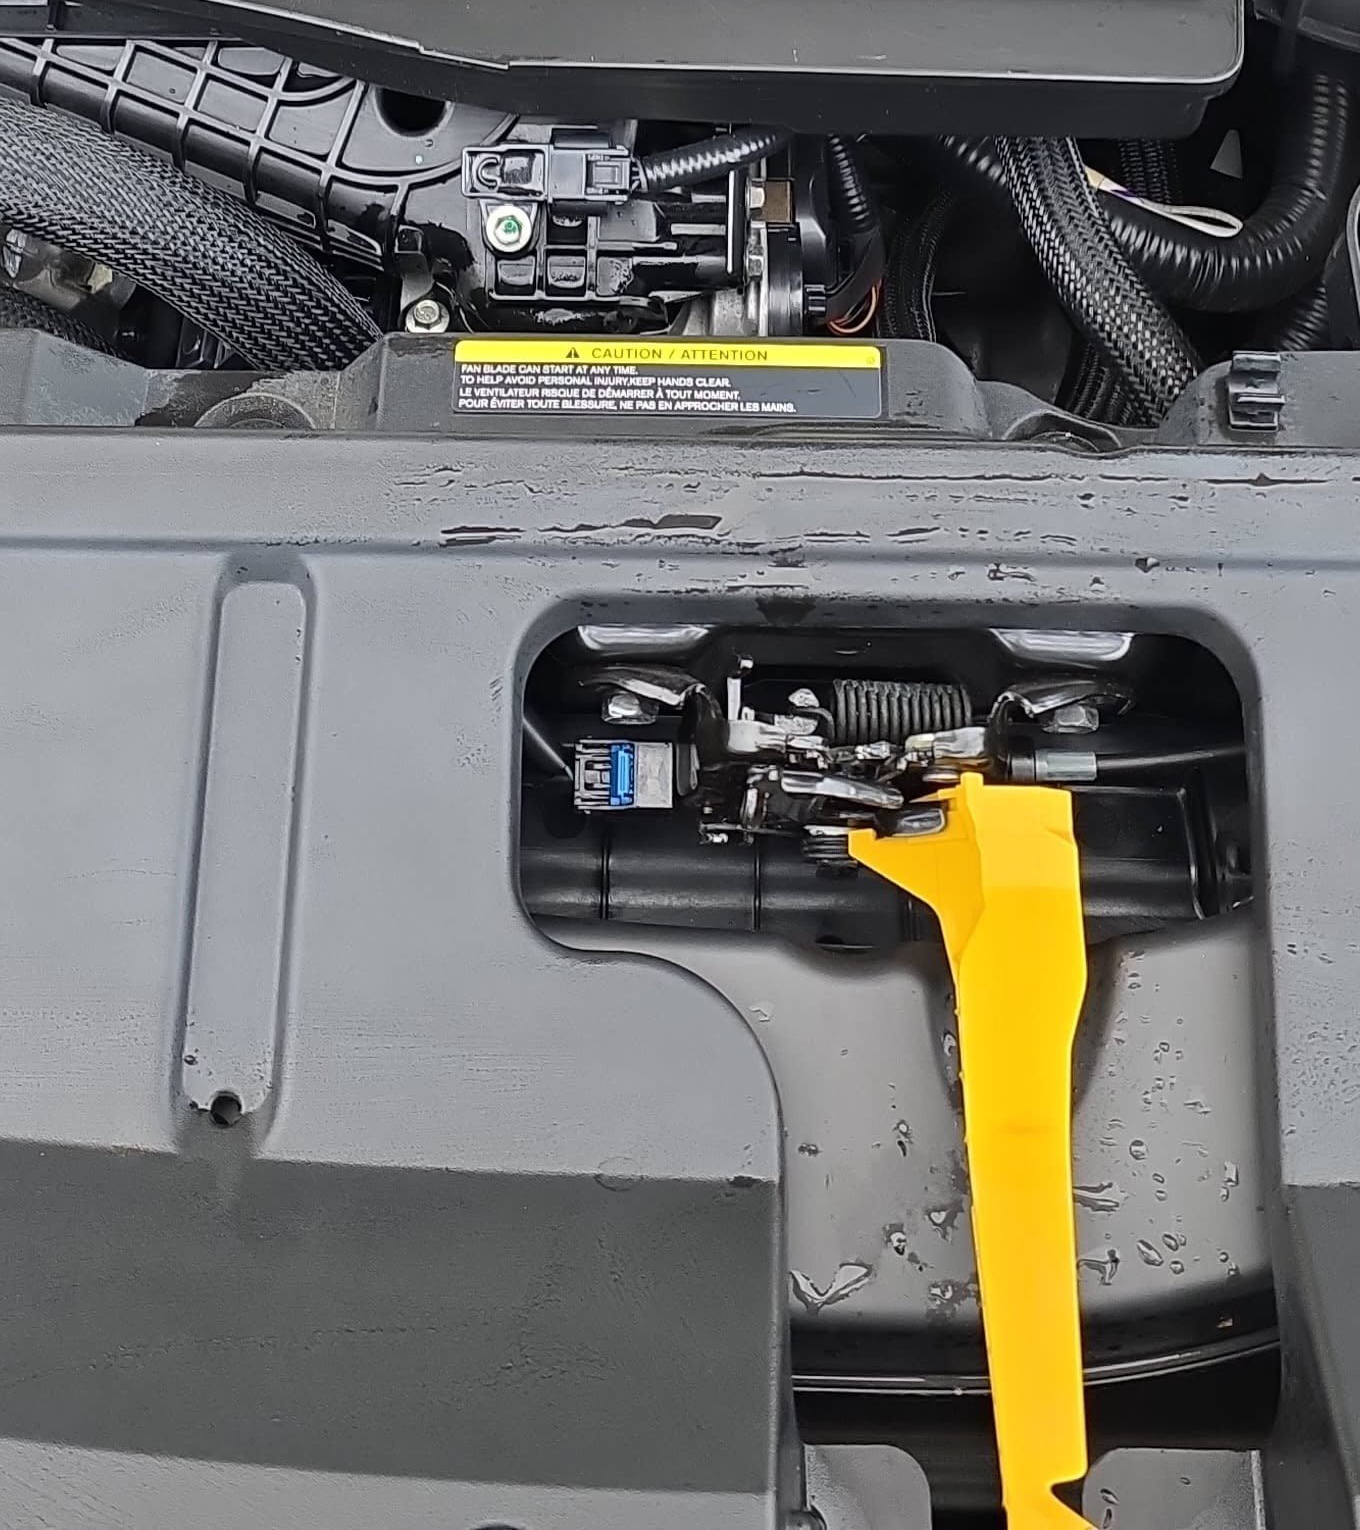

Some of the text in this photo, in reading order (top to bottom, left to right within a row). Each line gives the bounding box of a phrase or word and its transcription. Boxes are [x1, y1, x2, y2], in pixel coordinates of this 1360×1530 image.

[591, 347, 662, 359] CAUTION
[681, 349, 768, 361] ATTENTION
[461, 364, 639, 375] FAN BLADE CAN START AT ANY TIME.
[460, 375, 475, 384] TO
[477, 375, 504, 384] HELP
[504, 376, 536, 385] AVOID
[538, 376, 592, 385] PERSONAL
[657, 377, 693, 387] HANDS
[695, 377, 732, 387] CLEAR.
[459, 386, 741, 400] LE VENTILATEUR RISQUE DE DÉMARRER À TOUT MOMENT.
[458, 396, 796, 413] POUR ÉVITER TOUTE BLESSURE, NE PAS EN APPROCHER LES MAINS.
